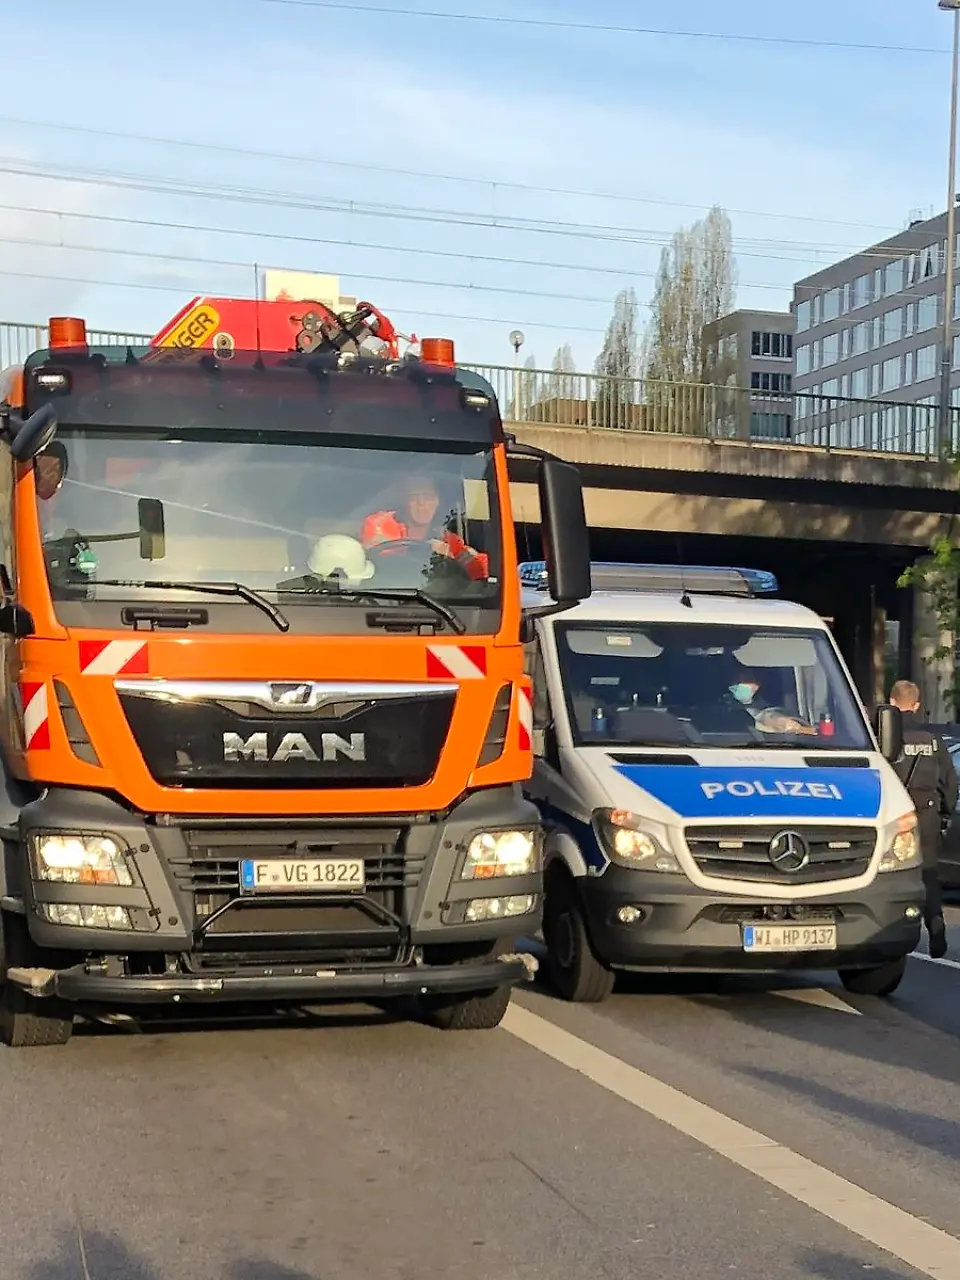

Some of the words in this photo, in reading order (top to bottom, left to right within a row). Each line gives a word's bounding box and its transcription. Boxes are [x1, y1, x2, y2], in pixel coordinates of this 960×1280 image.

[223, 732, 366, 762] MAN
[904, 740, 938, 756] OLIZEI
[701, 780, 842, 800] POLIZEI
[256, 864, 269, 882] F
[283, 864, 308, 882] VG
[312, 864, 361, 882] 1822
[755, 929, 771, 946] WI
[783, 929, 800, 945] HP
[802, 929, 833, 945] 9137
